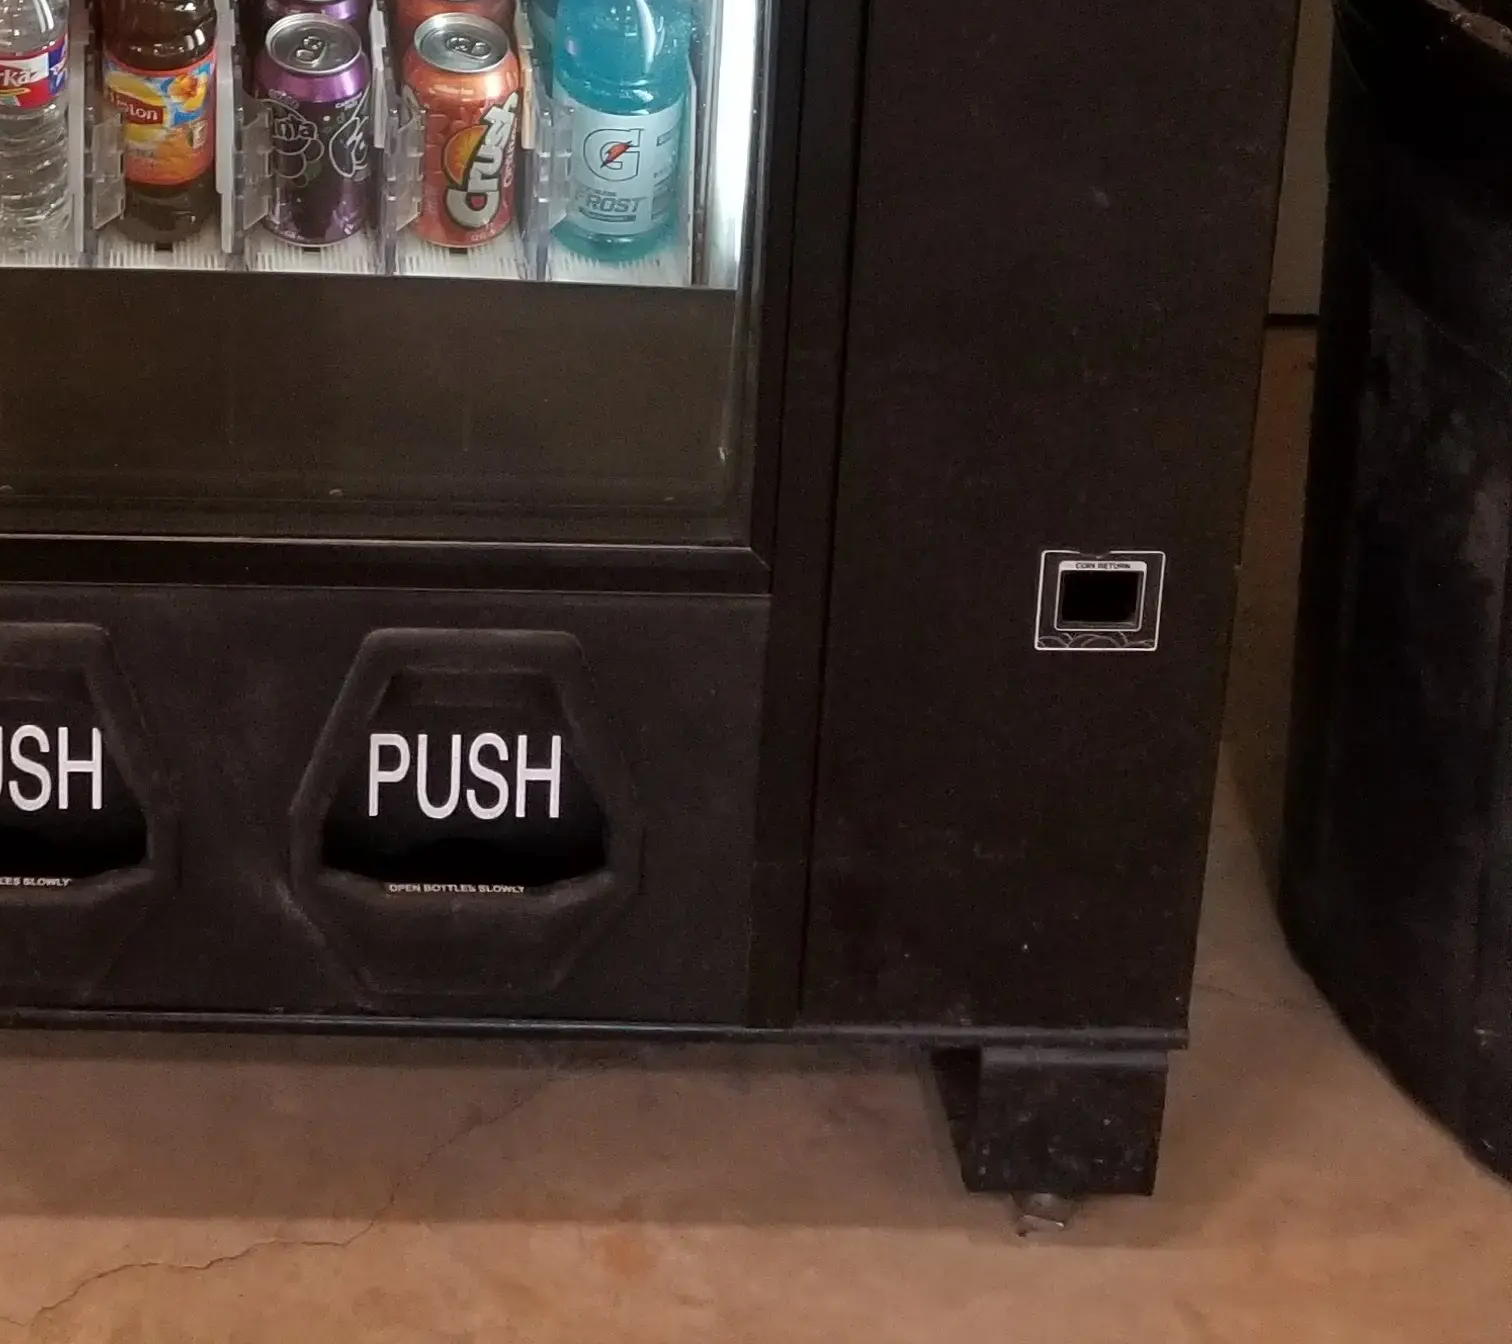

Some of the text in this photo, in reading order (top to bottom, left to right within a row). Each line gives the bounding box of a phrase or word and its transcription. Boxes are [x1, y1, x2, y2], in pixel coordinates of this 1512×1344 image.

[446, 91, 519, 228] Crush
[583, 128, 644, 182] G
[368, 733, 561, 820] PUSH
[23, 878, 71, 886] SLOWLY
[389, 884, 524, 893] OPEN BOTTLES SLOWLY
